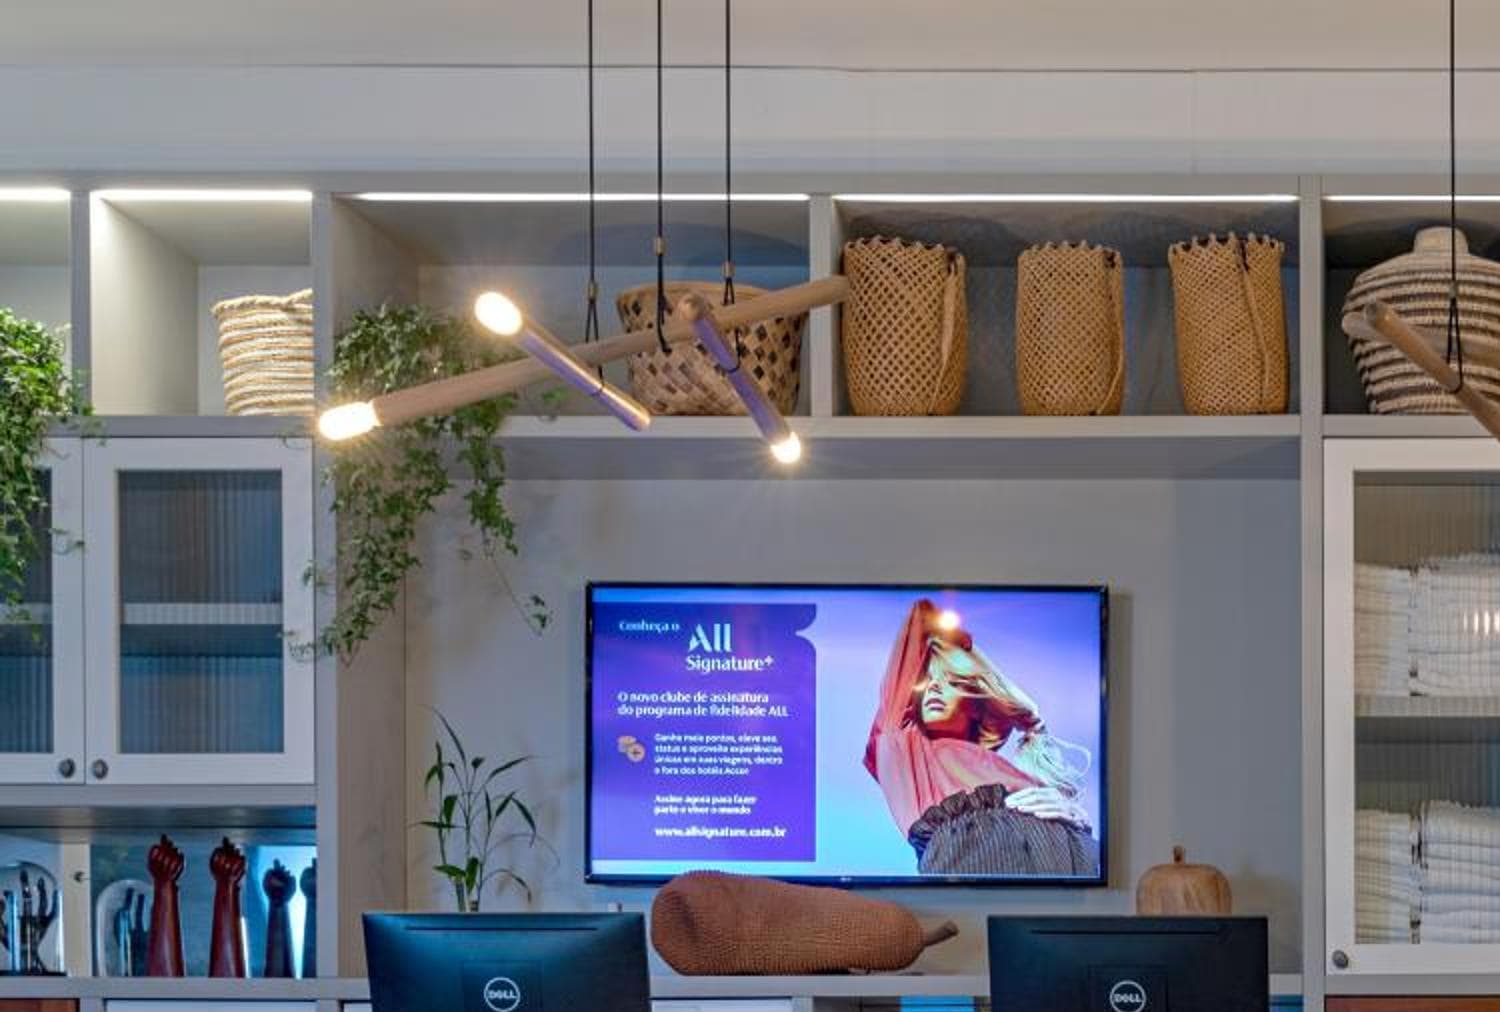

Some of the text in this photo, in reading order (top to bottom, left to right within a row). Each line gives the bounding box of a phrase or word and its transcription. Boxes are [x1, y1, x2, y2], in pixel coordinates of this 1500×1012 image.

[619, 619, 680, 633] Conheça o
[688, 623, 732, 653] All
[617, 691, 769, 703] O novo clube de assinatura
[617, 704, 788, 718] do programa de fidelidade ALL
[689, 744, 729, 754] aproveite
[661, 766, 678, 775] fora
[679, 766, 696, 775] dos
[655, 825, 786, 839] www.allsignature.com.br
[488, 989, 518, 1000] DELL
[1113, 993, 1142, 1003] DELL
